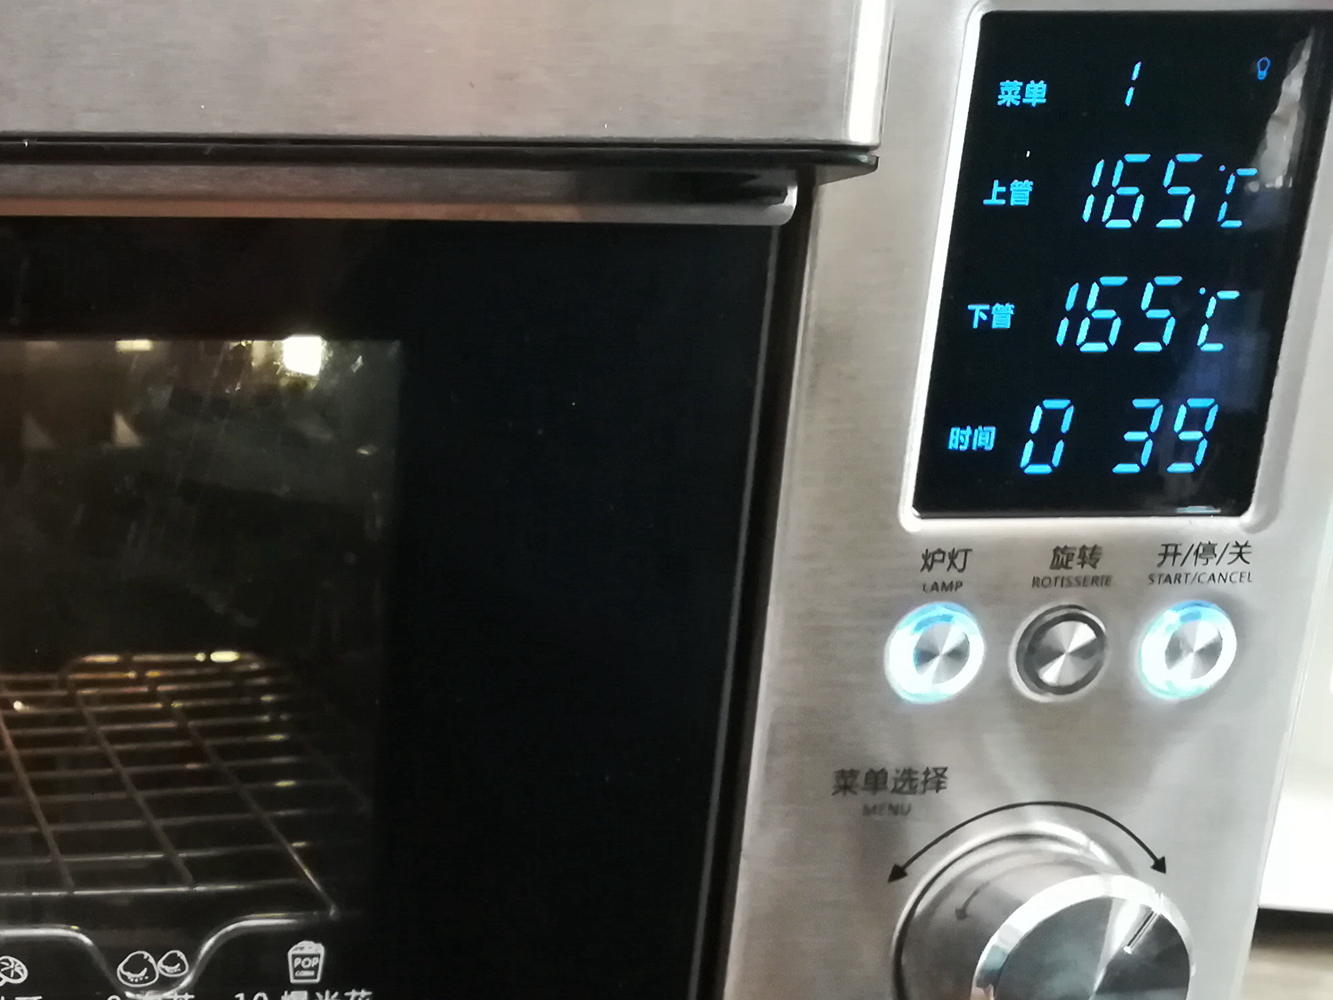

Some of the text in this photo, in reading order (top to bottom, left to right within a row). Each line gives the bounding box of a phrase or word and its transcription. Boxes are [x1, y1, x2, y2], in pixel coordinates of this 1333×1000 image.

[997, 79, 1048, 107] 菜单
[982, 179, 1034, 207] 上管
[967, 302, 1016, 331] 下管
[947, 425, 997, 452] 时间
[919, 547, 974, 573] 炉灯
[1049, 543, 1103, 570] 旋转
[922, 579, 964, 594] LAMP
[1031, 574, 1113, 590] ROTISSERIE
[1148, 571, 1253, 586] START/CANCEL
[831, 766, 949, 797] 菜单选择
